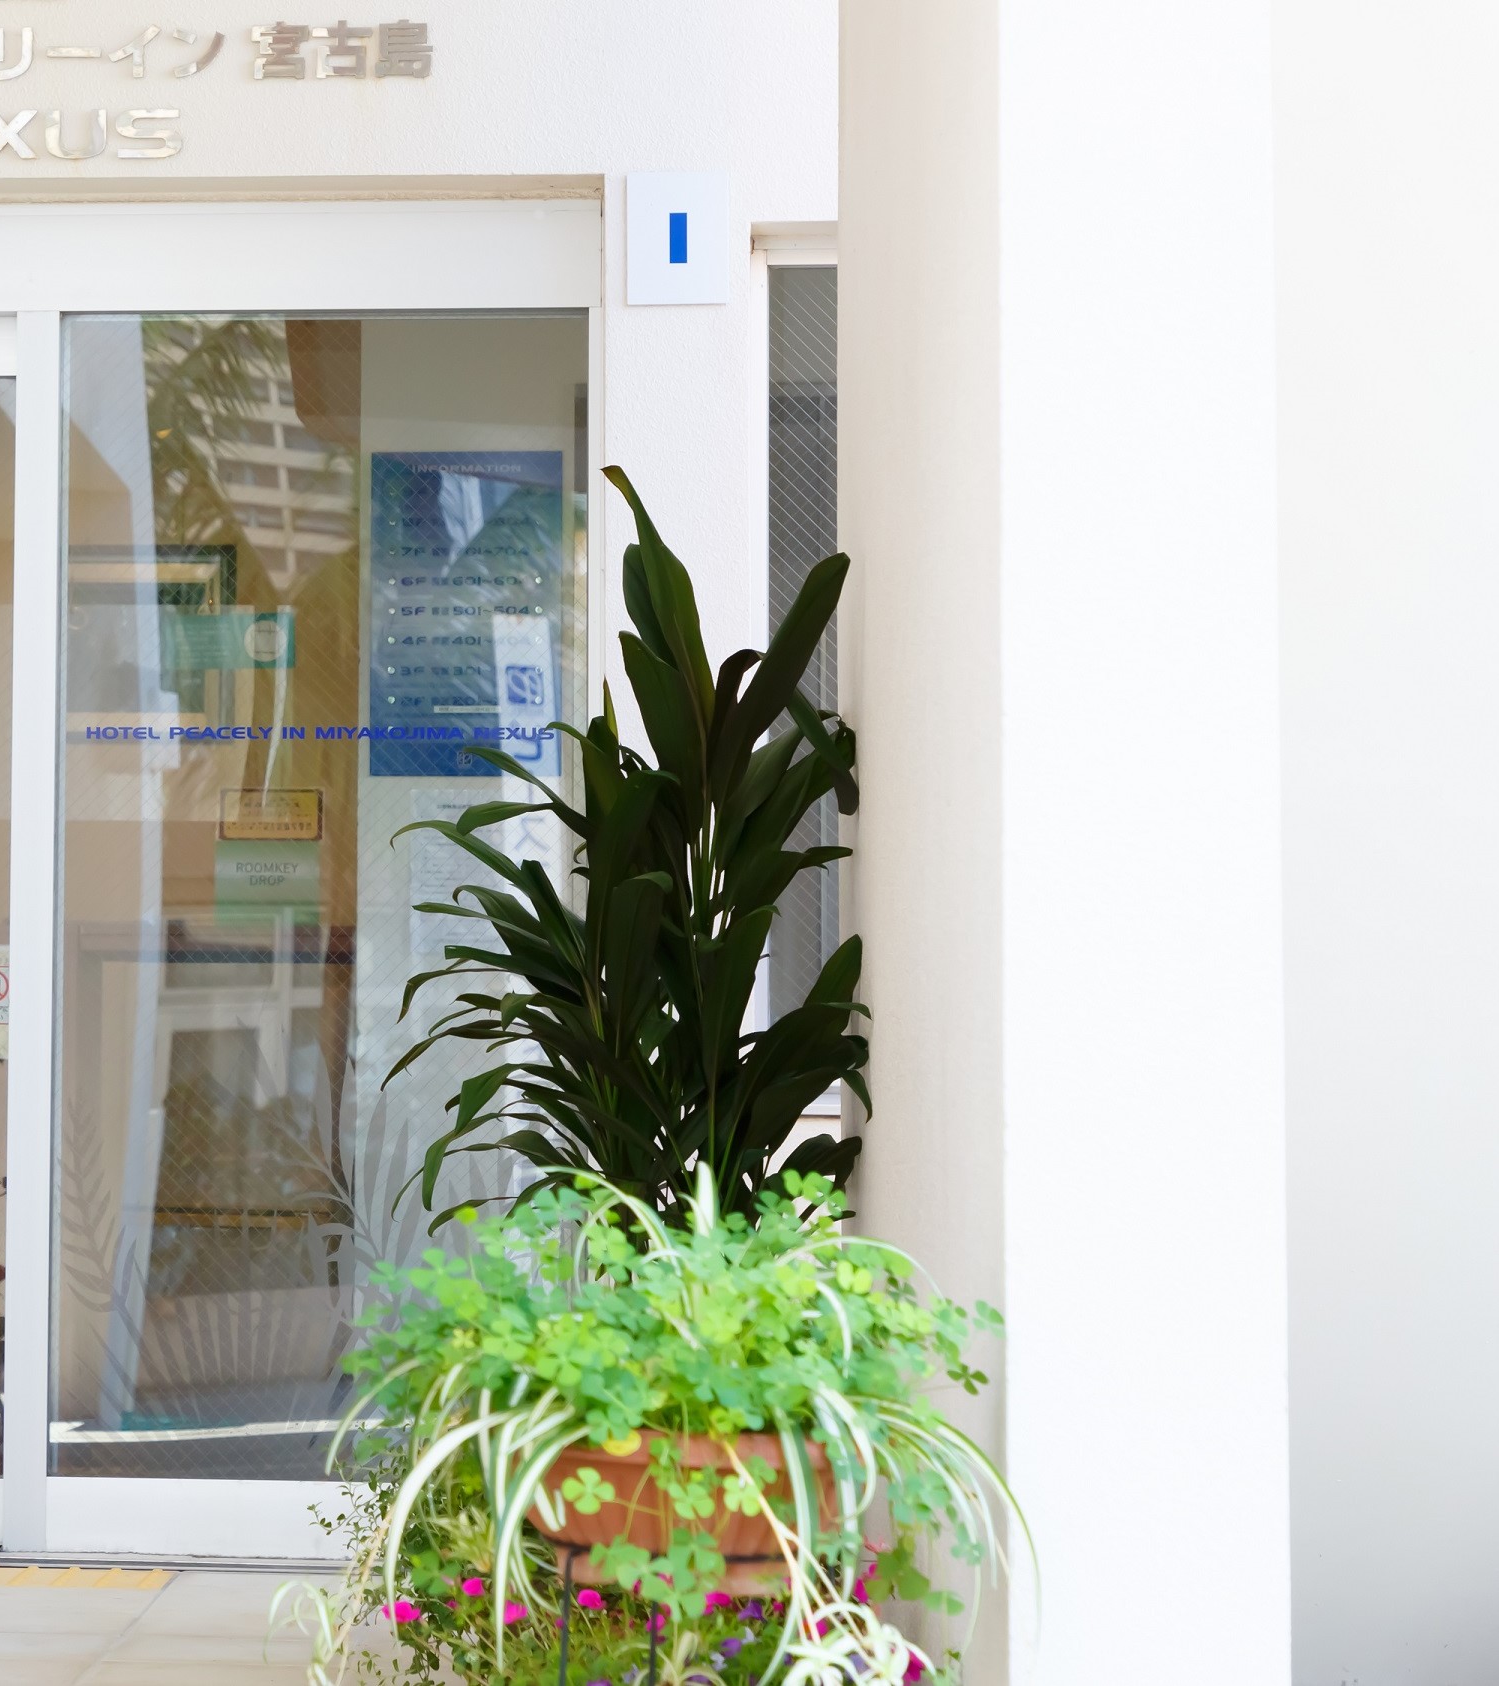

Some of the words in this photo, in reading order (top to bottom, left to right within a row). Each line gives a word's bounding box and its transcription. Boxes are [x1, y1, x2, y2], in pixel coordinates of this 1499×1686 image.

[251, 19, 434, 80] 宮古島
[412, 464, 522, 473] INFORMATION
[401, 576, 427, 586] 6F
[401, 606, 426, 616] 5F
[401, 636, 427, 646] 4F
[85, 726, 160, 740] HOTEL
[169, 726, 274, 740] PEACELY
[282, 726, 306, 740] IN
[315, 726, 464, 740] MIYAKOJIMA
[474, 726, 556, 740] NEXUS
[235, 862, 299, 873] ROOMKEY
[249, 874, 286, 886] DROP
